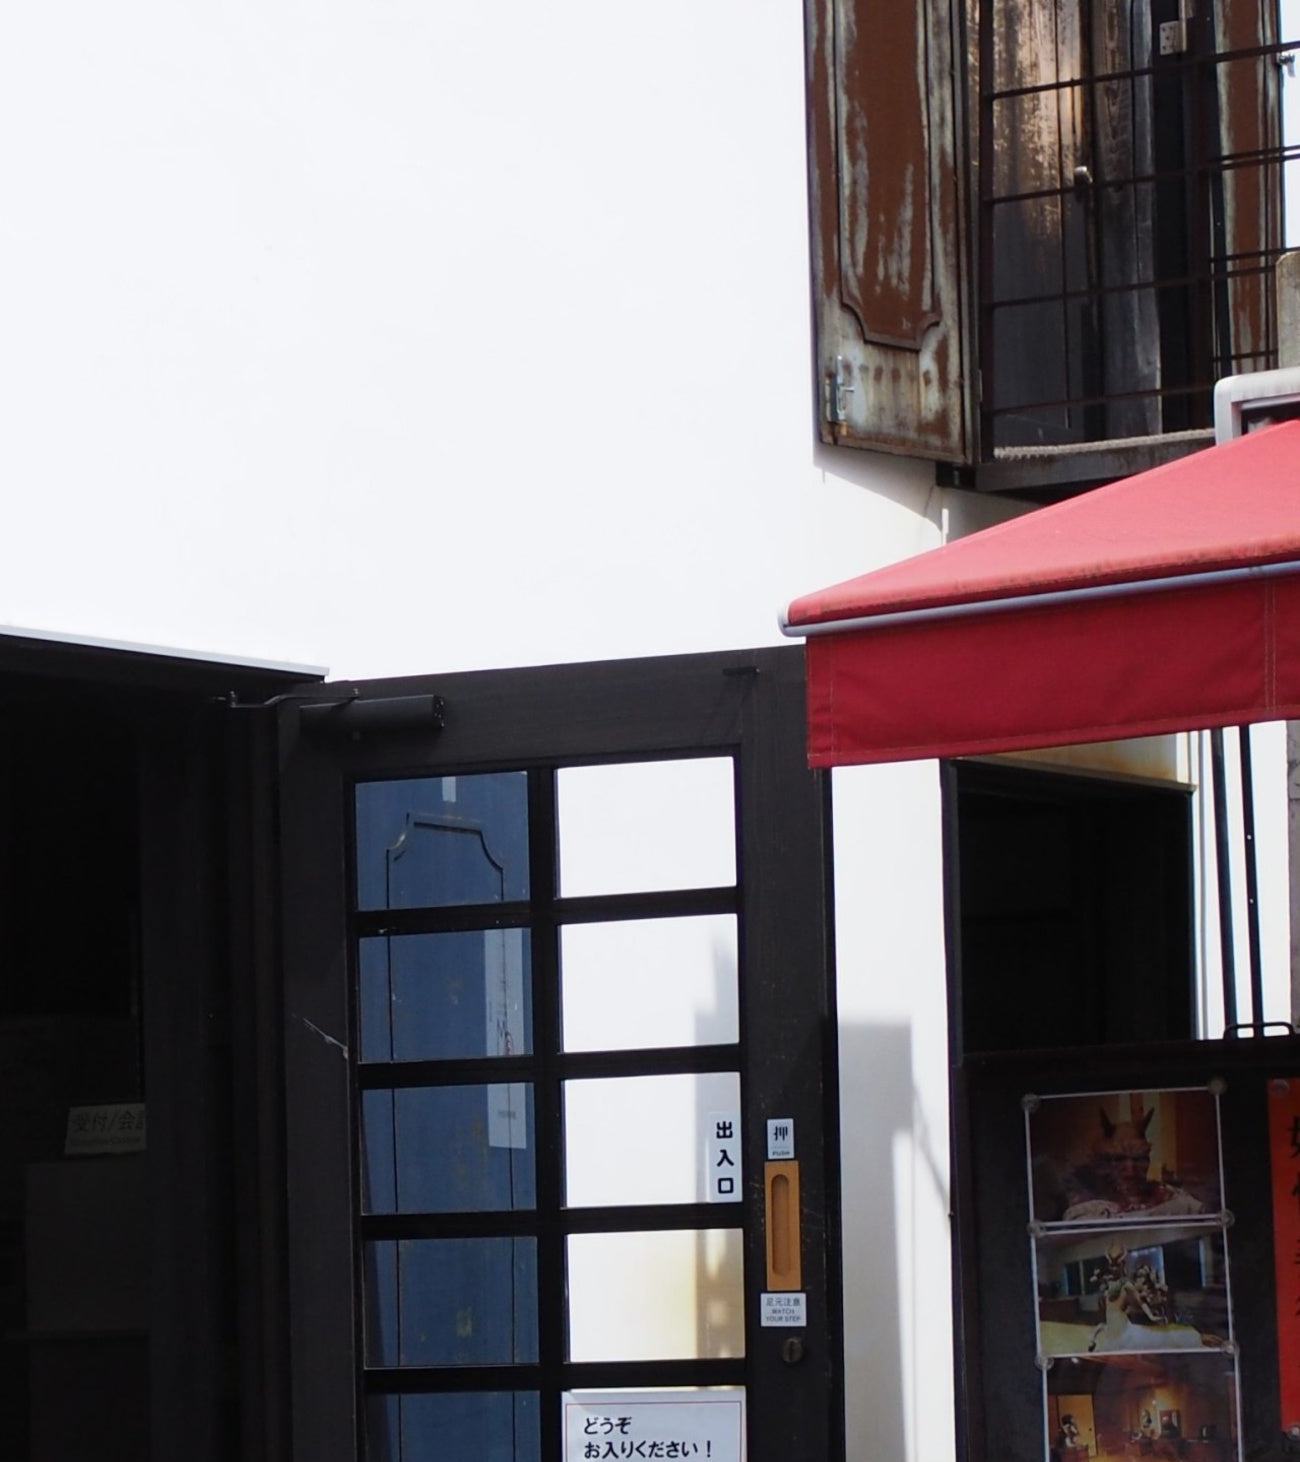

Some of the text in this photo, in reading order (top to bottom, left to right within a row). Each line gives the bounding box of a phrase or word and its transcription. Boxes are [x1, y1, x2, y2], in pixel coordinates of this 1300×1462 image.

[716, 1120, 735, 1194] 出入口
[583, 1416, 632, 1435] どうぞ
